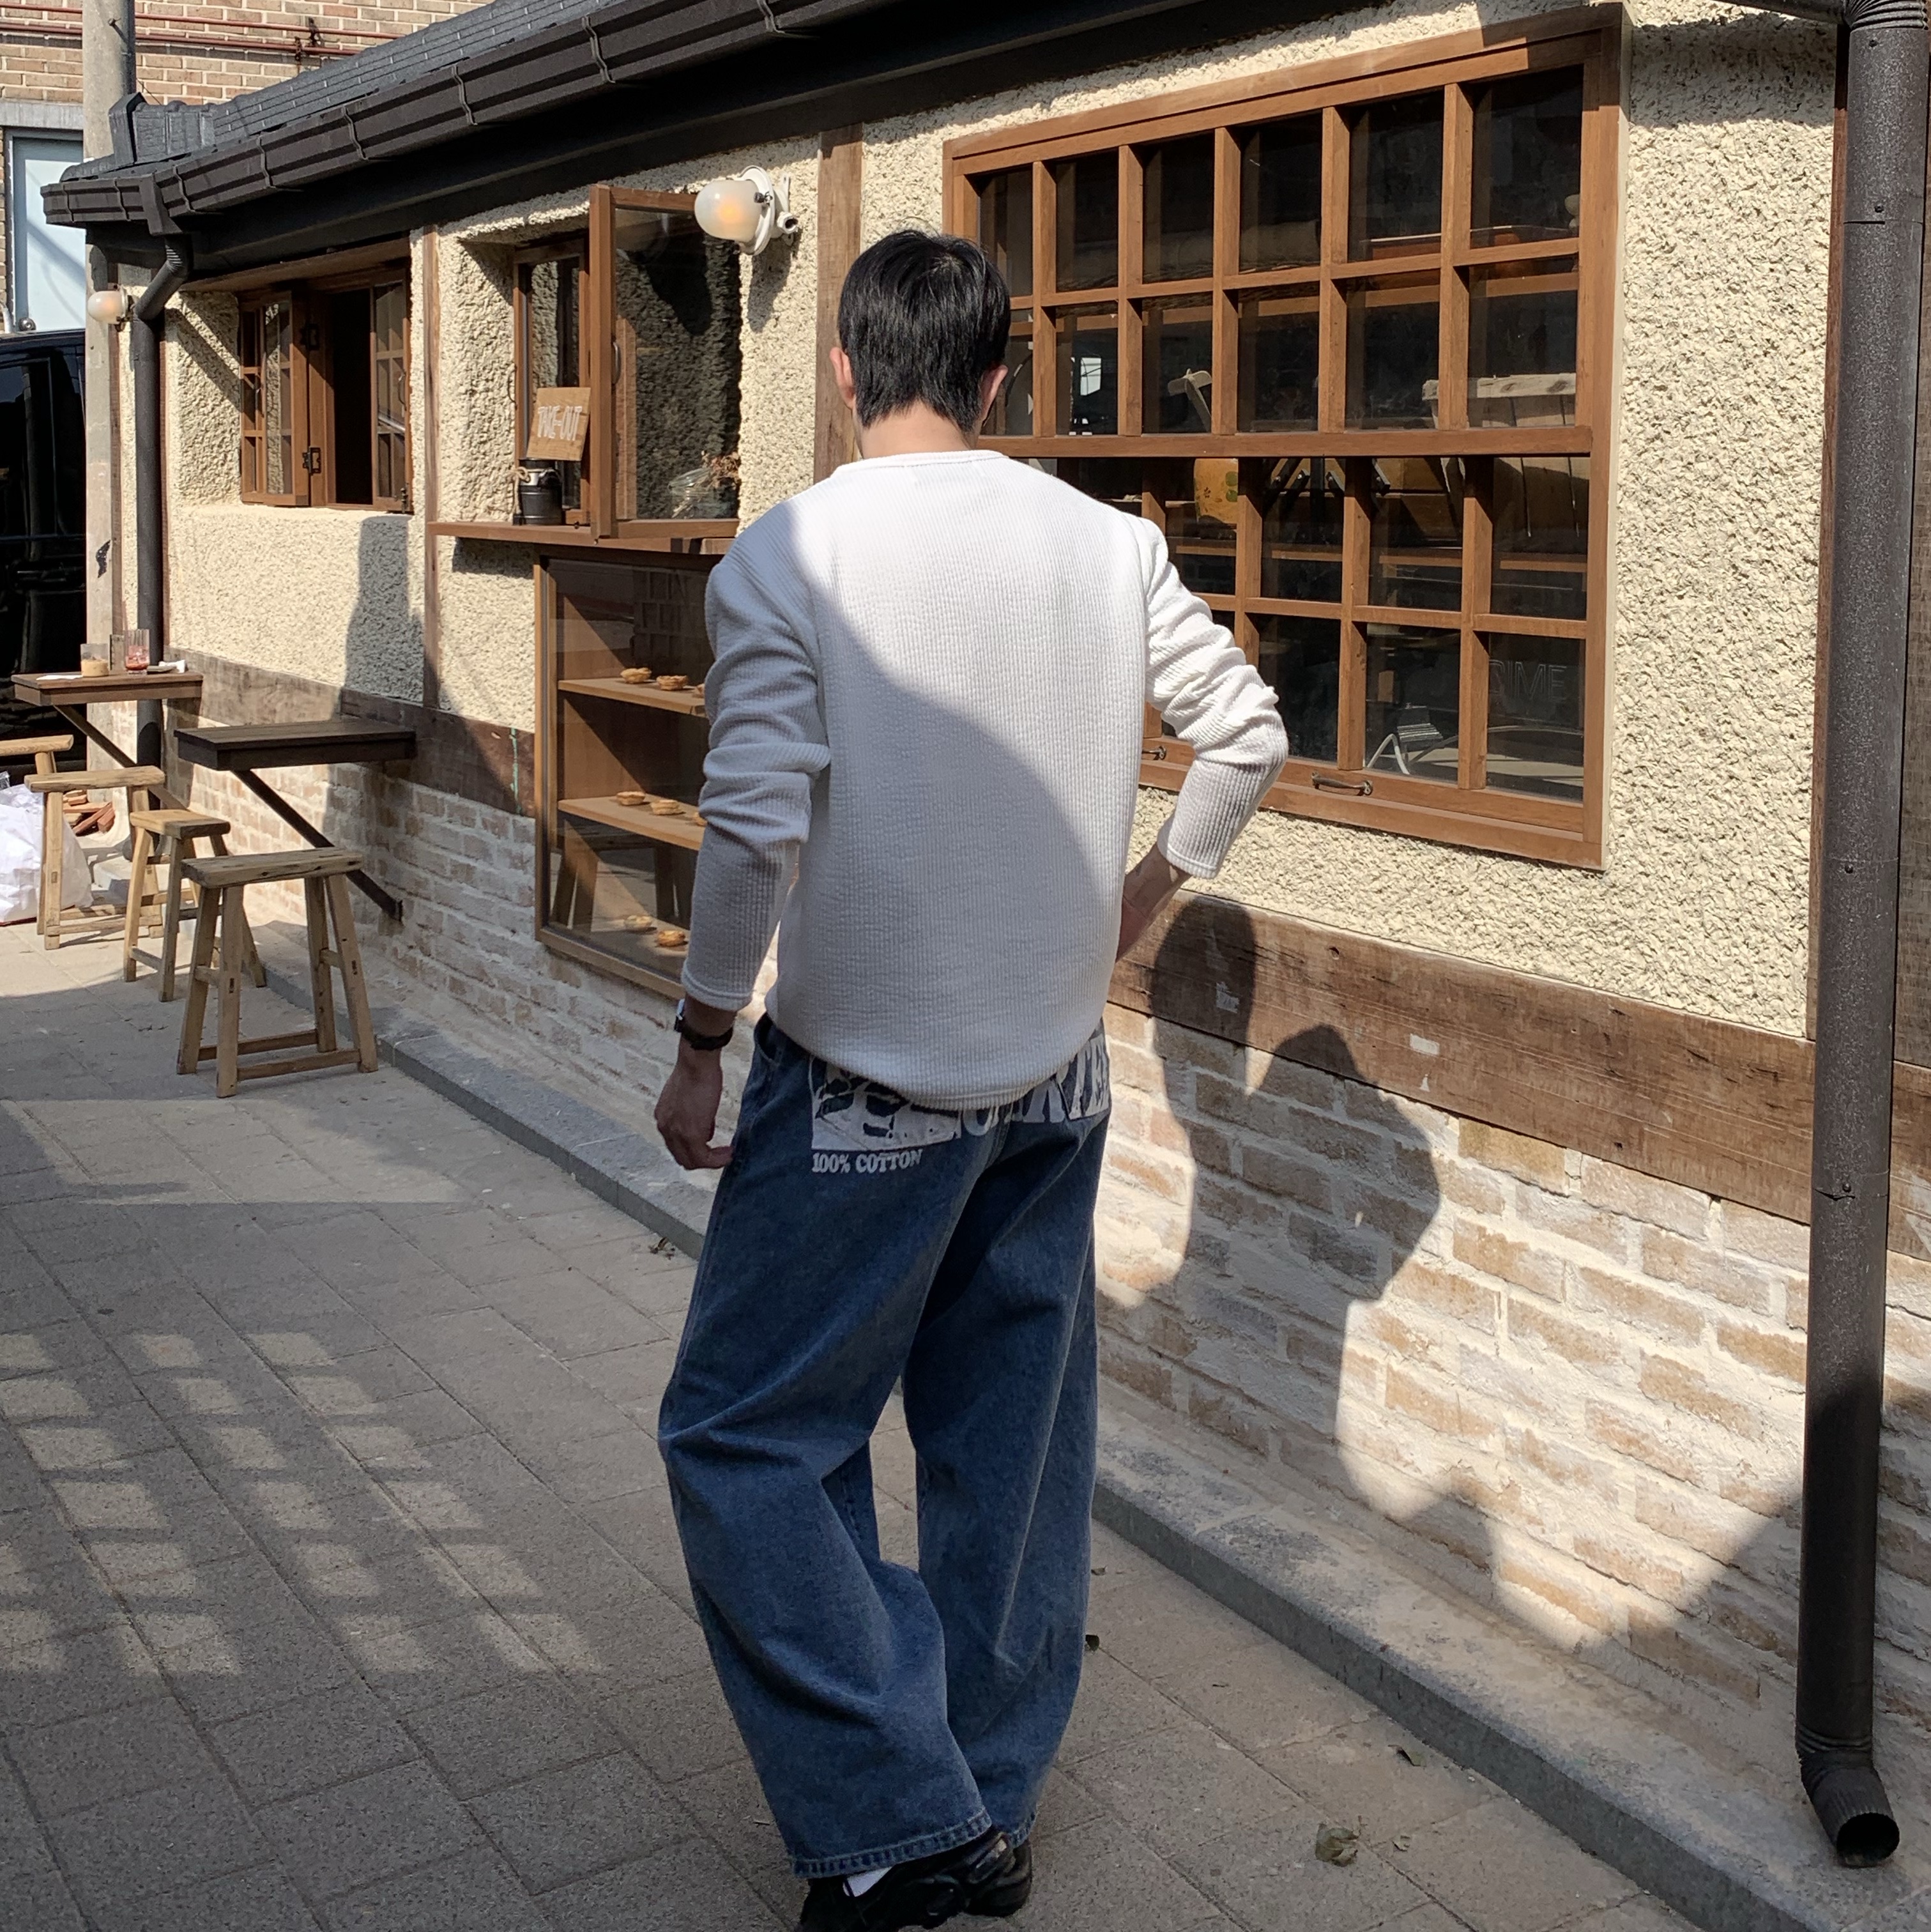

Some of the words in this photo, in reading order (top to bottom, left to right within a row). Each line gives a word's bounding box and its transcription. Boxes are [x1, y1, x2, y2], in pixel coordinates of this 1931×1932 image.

[537, 405, 583, 441] TAKE-OUT
[812, 1152, 851, 1173] 100%
[855, 1149, 923, 1174] COTTON
